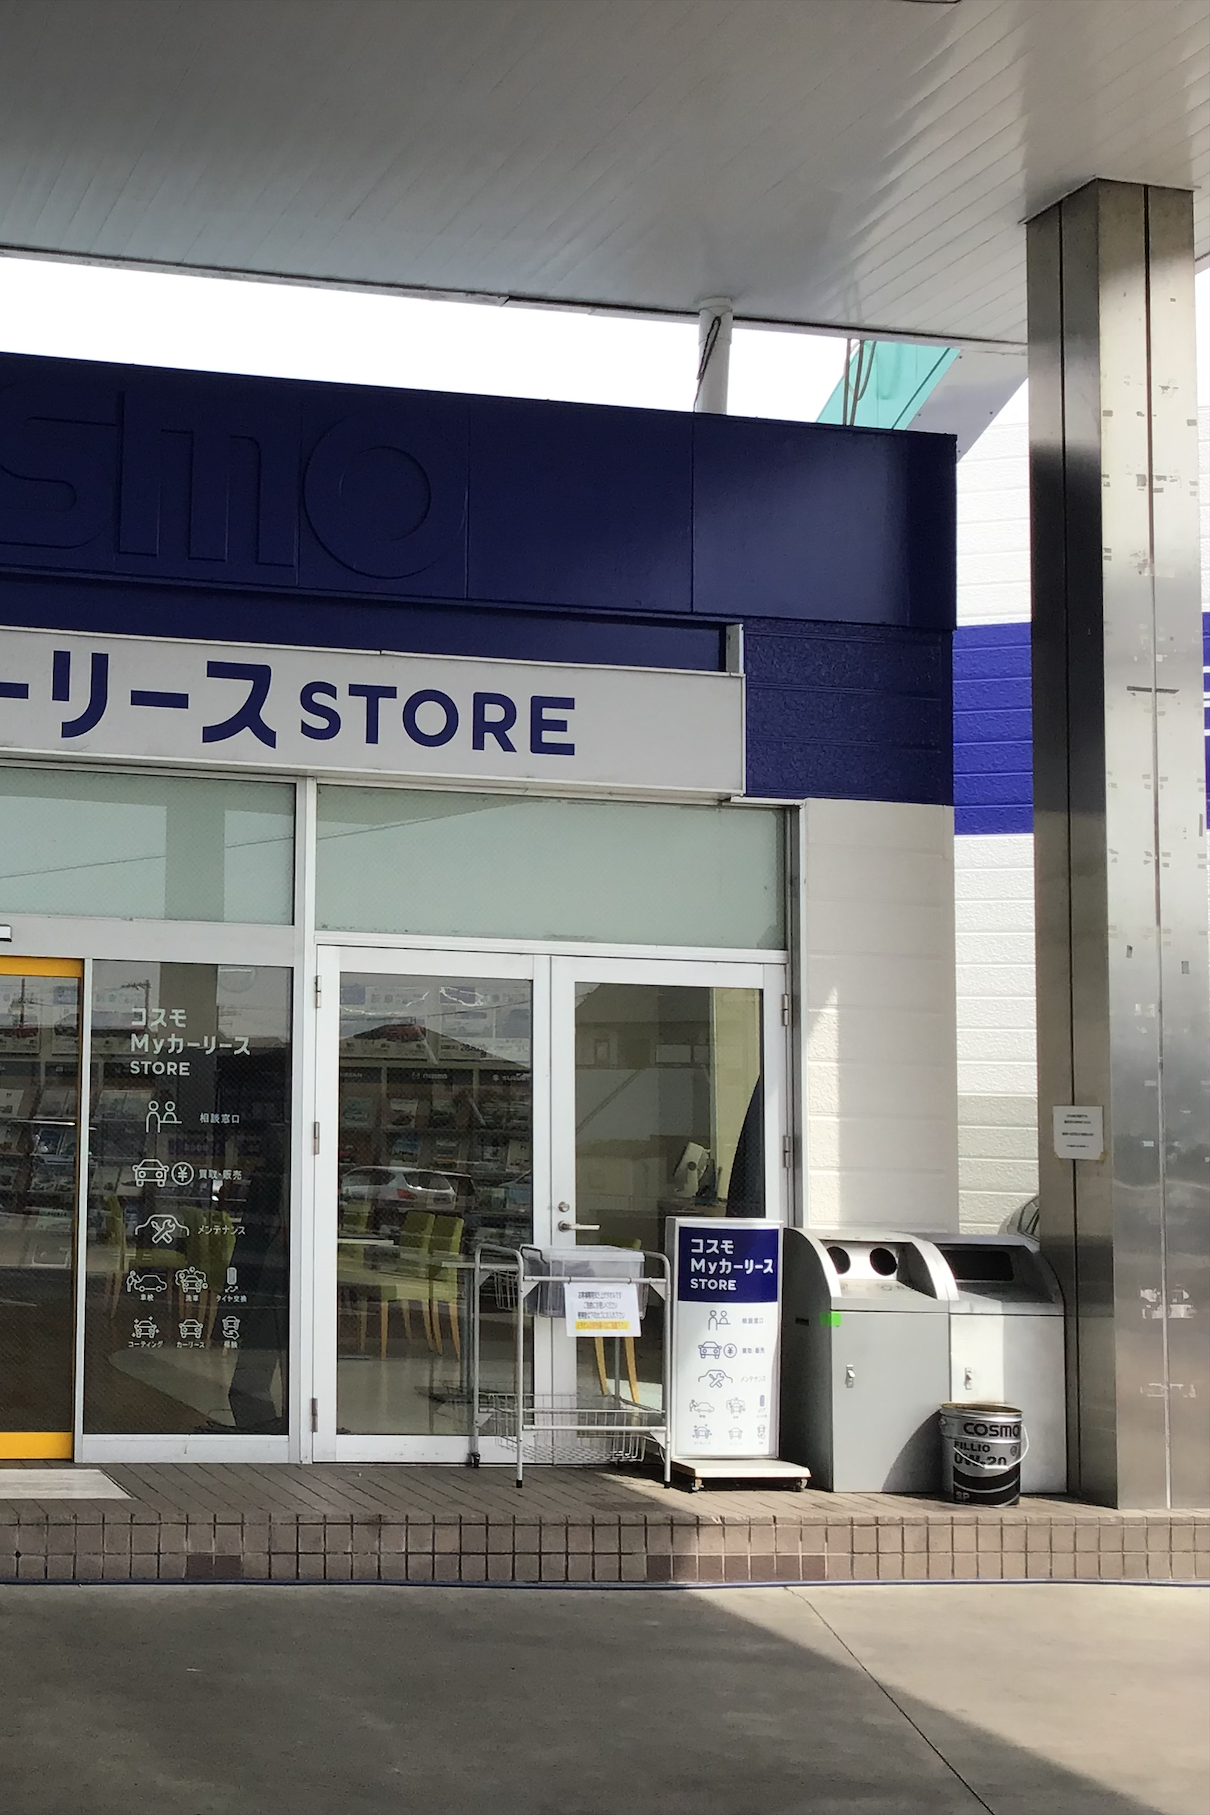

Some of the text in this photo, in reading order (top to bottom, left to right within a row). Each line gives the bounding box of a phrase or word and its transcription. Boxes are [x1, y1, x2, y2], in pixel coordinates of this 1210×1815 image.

[131, 1007, 187, 1028] コスモ
[130, 1033, 250, 1056] Myカーリース
[130, 1060, 190, 1076] STORE
[199, 1113, 240, 1124] 相談窓口
[198, 1169, 242, 1180] 買取・販売
[197, 1225, 246, 1236] メンテナンス
[690, 1238, 735, 1255] コスモ
[690, 1257, 774, 1275] Myカーリース
[690, 1278, 737, 1291] STORE
[216, 1294, 248, 1303] タイヤ交換
[177, 1341, 205, 1349] カーリース
[740, 1375, 766, 1383] メンテナンス
[963, 1422, 1021, 1438] COSMO
[954, 1441, 991, 1453] FILLIO
[955, 1491, 970, 1500] SP
